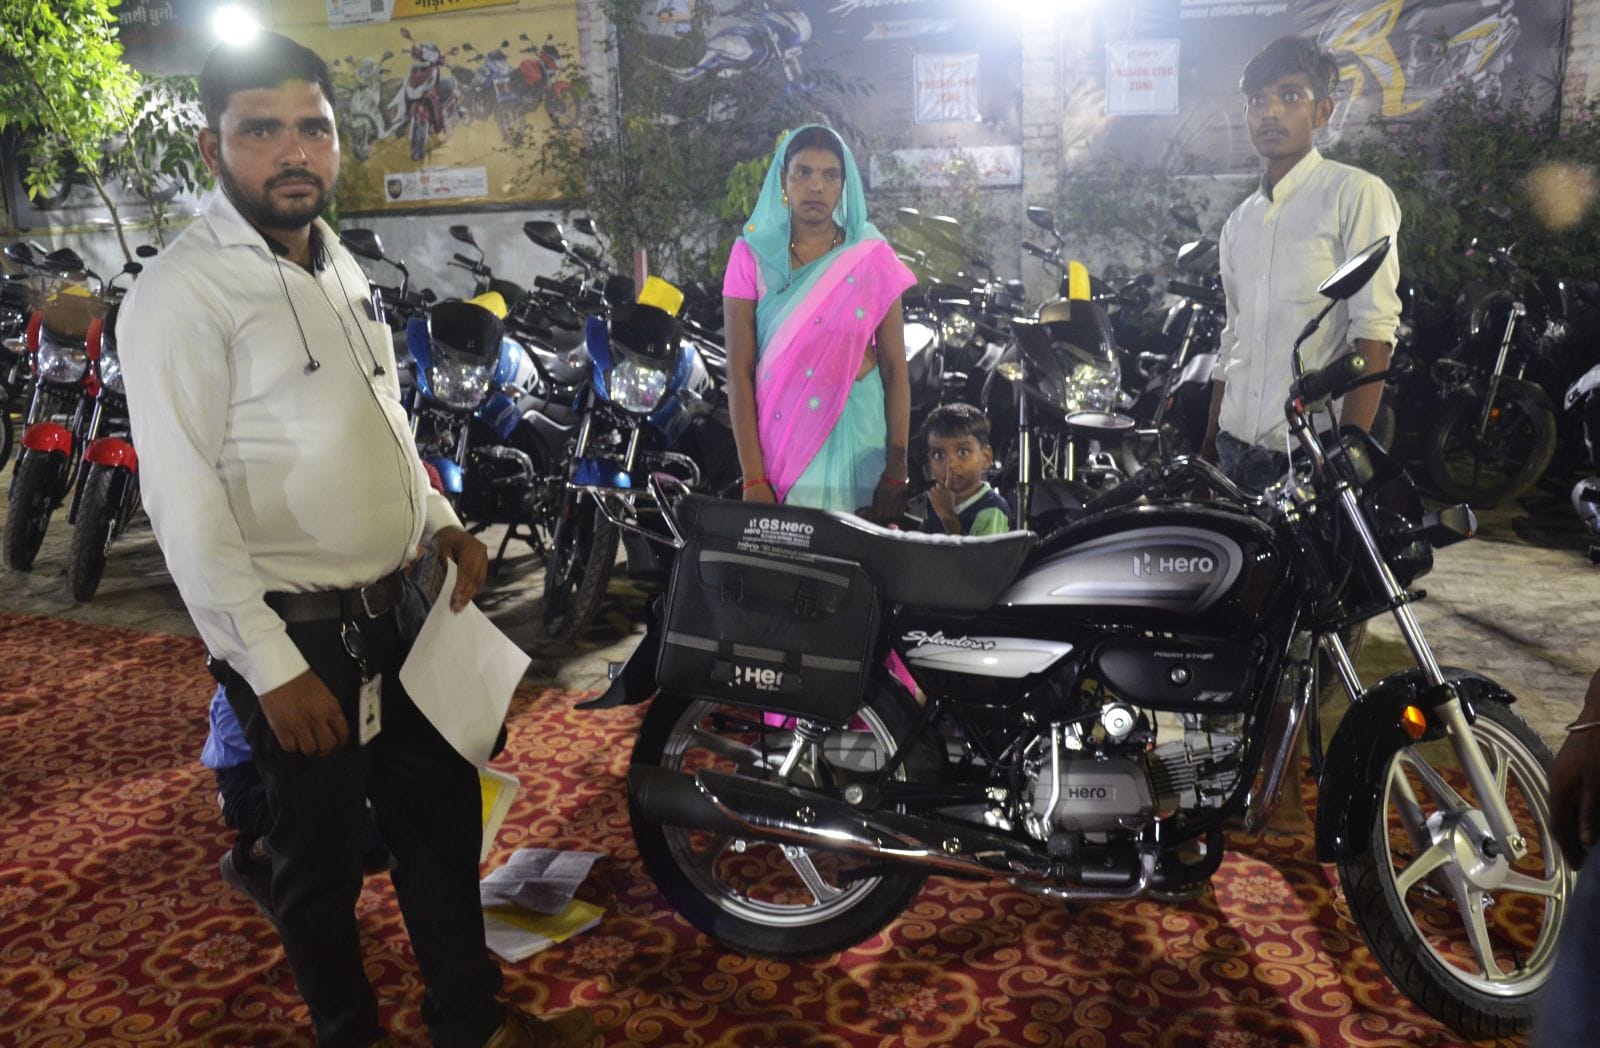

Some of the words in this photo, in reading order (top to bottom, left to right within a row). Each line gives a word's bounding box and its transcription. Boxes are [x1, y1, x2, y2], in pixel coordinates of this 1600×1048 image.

[1159, 556, 1214, 573] Hero
[745, 666, 783, 685] Her
[1068, 787, 1106, 798] Hero
